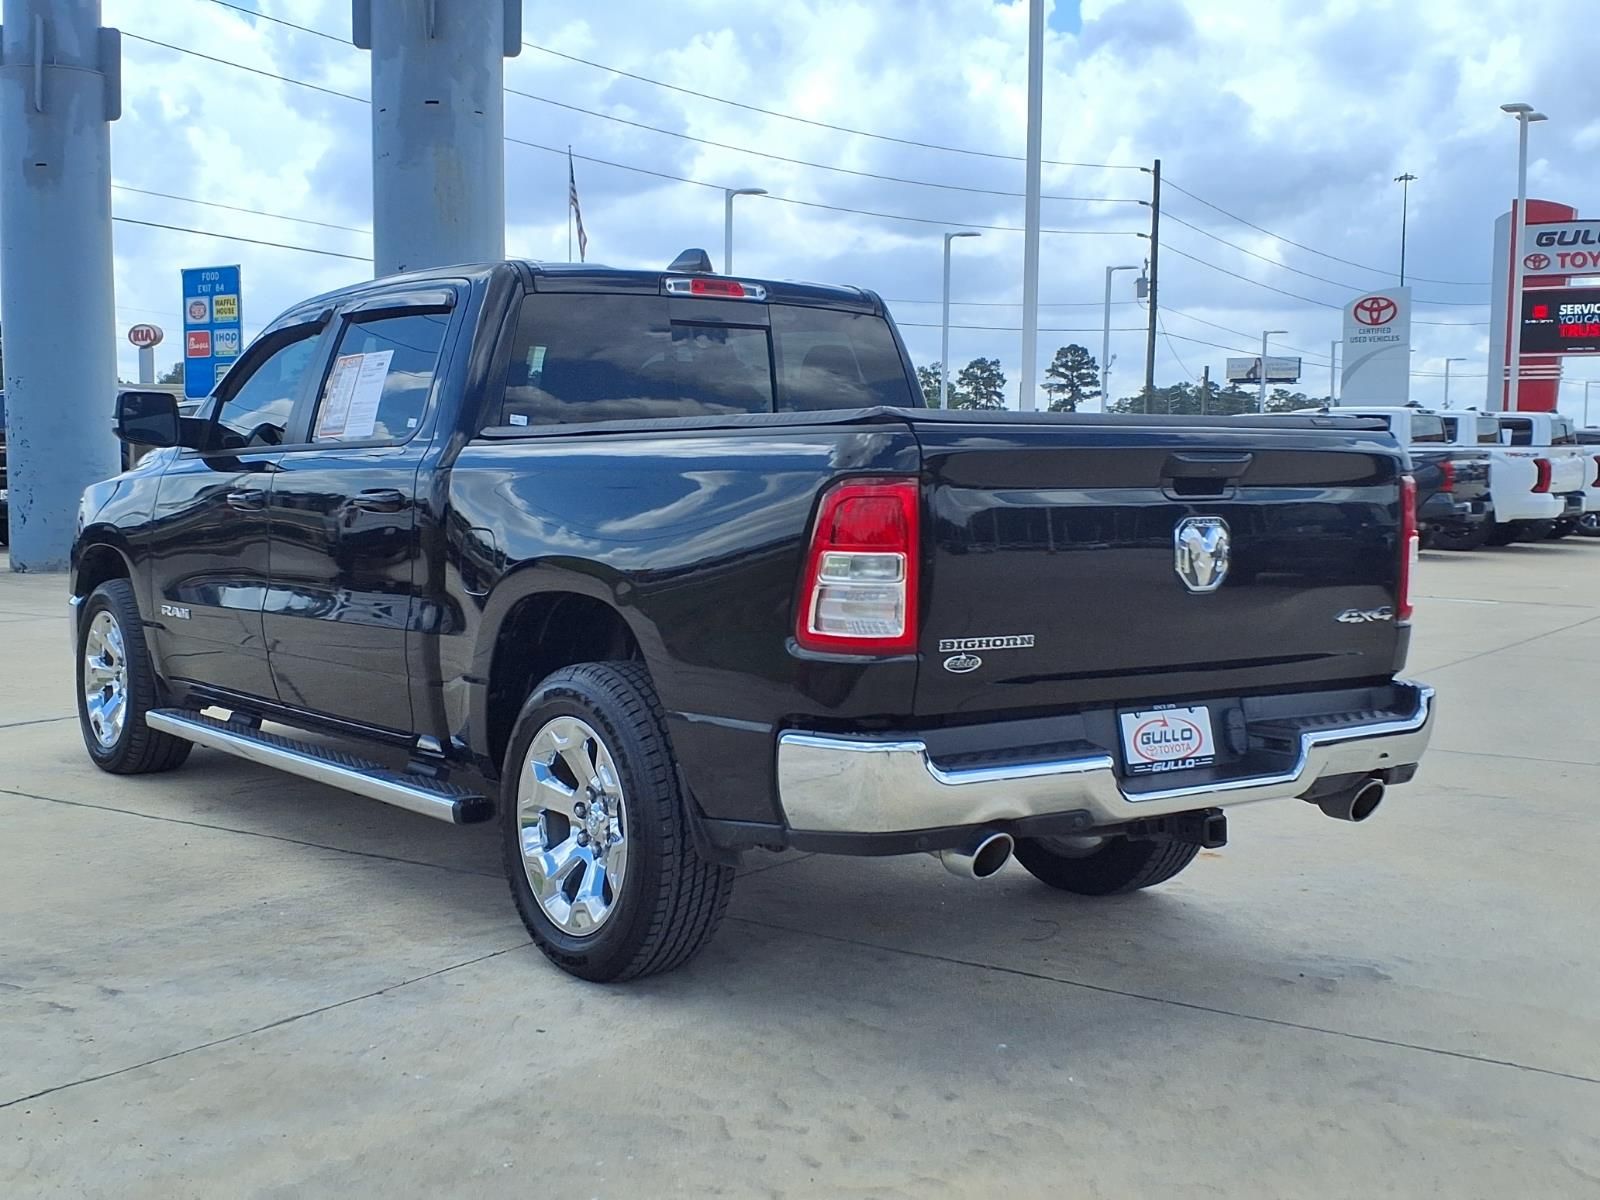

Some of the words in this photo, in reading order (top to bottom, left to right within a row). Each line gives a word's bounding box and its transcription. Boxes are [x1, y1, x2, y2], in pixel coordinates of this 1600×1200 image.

[1536, 229, 1600, 247] GUL
[201, 271, 220, 281] FOOD
[197, 283, 211, 294] EXIT
[214, 298, 236, 306] WAFFLE
[216, 307, 235, 315] HOUSE
[1559, 315, 1583, 325] YOU
[133, 329, 152, 342] KIA
[1358, 327, 1392, 335] CERTIFIED
[161, 604, 191, 619] RAM
[939, 635, 1035, 652] BIGHORN
[1141, 728, 1193, 745] GULLO
[1159, 743, 1192, 754] TOYOTA
[1151, 758, 1195, 772] GULLO
